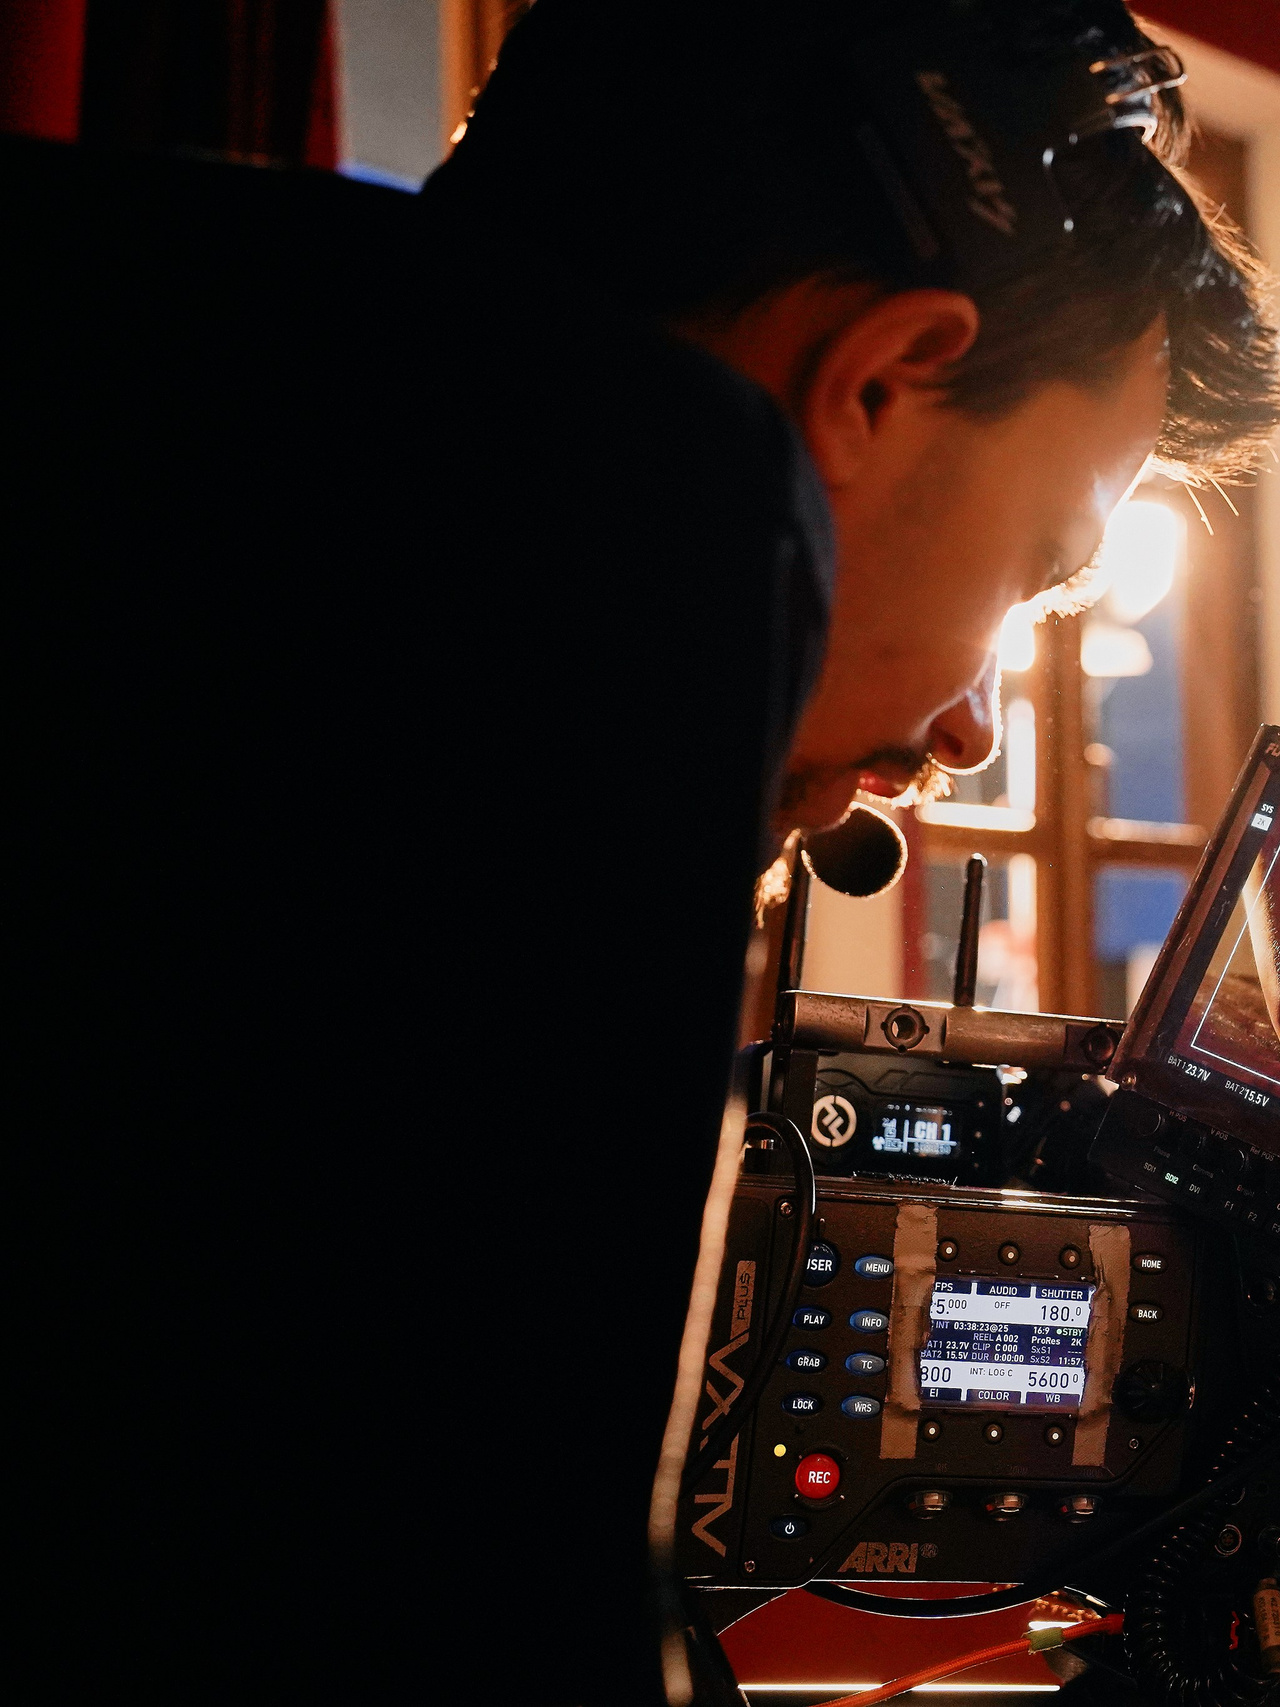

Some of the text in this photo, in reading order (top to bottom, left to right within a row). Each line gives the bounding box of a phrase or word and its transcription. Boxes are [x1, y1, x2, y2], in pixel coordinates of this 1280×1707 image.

[1261, 804, 1274, 814] SYS
[1167, 1055, 1180, 1067] BAT
[1185, 1063, 1211, 1082] 23.7V
[1225, 1080, 1239, 1092] BAT
[1244, 1087, 1270, 1107] 15.5V
[1165, 1172, 1179, 1185] SDI2
[1189, 1183, 1201, 1194] DVI
[1224, 1200, 1235, 1211] F1
[1247, 1211, 1258, 1222] F2
[865, 1263, 890, 1273] MENU
[1142, 1259, 1161, 1269] HOME
[934, 1281, 954, 1292] FPS
[989, 1285, 1018, 1296] AUDIO
[736, 1272, 751, 1321] PLUS
[1041, 1289, 1083, 1300] SHUTTER
[932, 1299, 967, 1315] 5.000
[994, 1301, 1011, 1309] OFF
[803, 1314, 825, 1325] PLAY
[1138, 1309, 1158, 1319] BACK
[861, 1317, 882, 1328] INFO
[936, 1321, 950, 1329] INT
[953, 1322, 1009, 1333] 03:38:23@25
[973, 1333, 994, 1342] REEL
[1033, 1327, 1083, 1337] 16:9 STBY
[926, 1341, 969, 1350] AT1 23.7V
[972, 1343, 991, 1351] CLIP
[1031, 1336, 1082, 1347] ProRes 2K
[946, 1351, 968, 1360] 15.5V
[971, 1352, 1024, 1363] DUR 0:00:00
[797, 1356, 821, 1368] GRAB
[861, 1360, 873, 1370] TC
[970, 1368, 1013, 1377] INT: LOG C
[929, 1389, 939, 1397] EI
[978, 1391, 1010, 1400] COLOR
[1045, 1394, 1061, 1402] WB
[792, 1399, 814, 1410] LOCK
[854, 1402, 872, 1413] WRS
[808, 1470, 831, 1484] REC
[837, 1542, 919, 1574] ARRI
